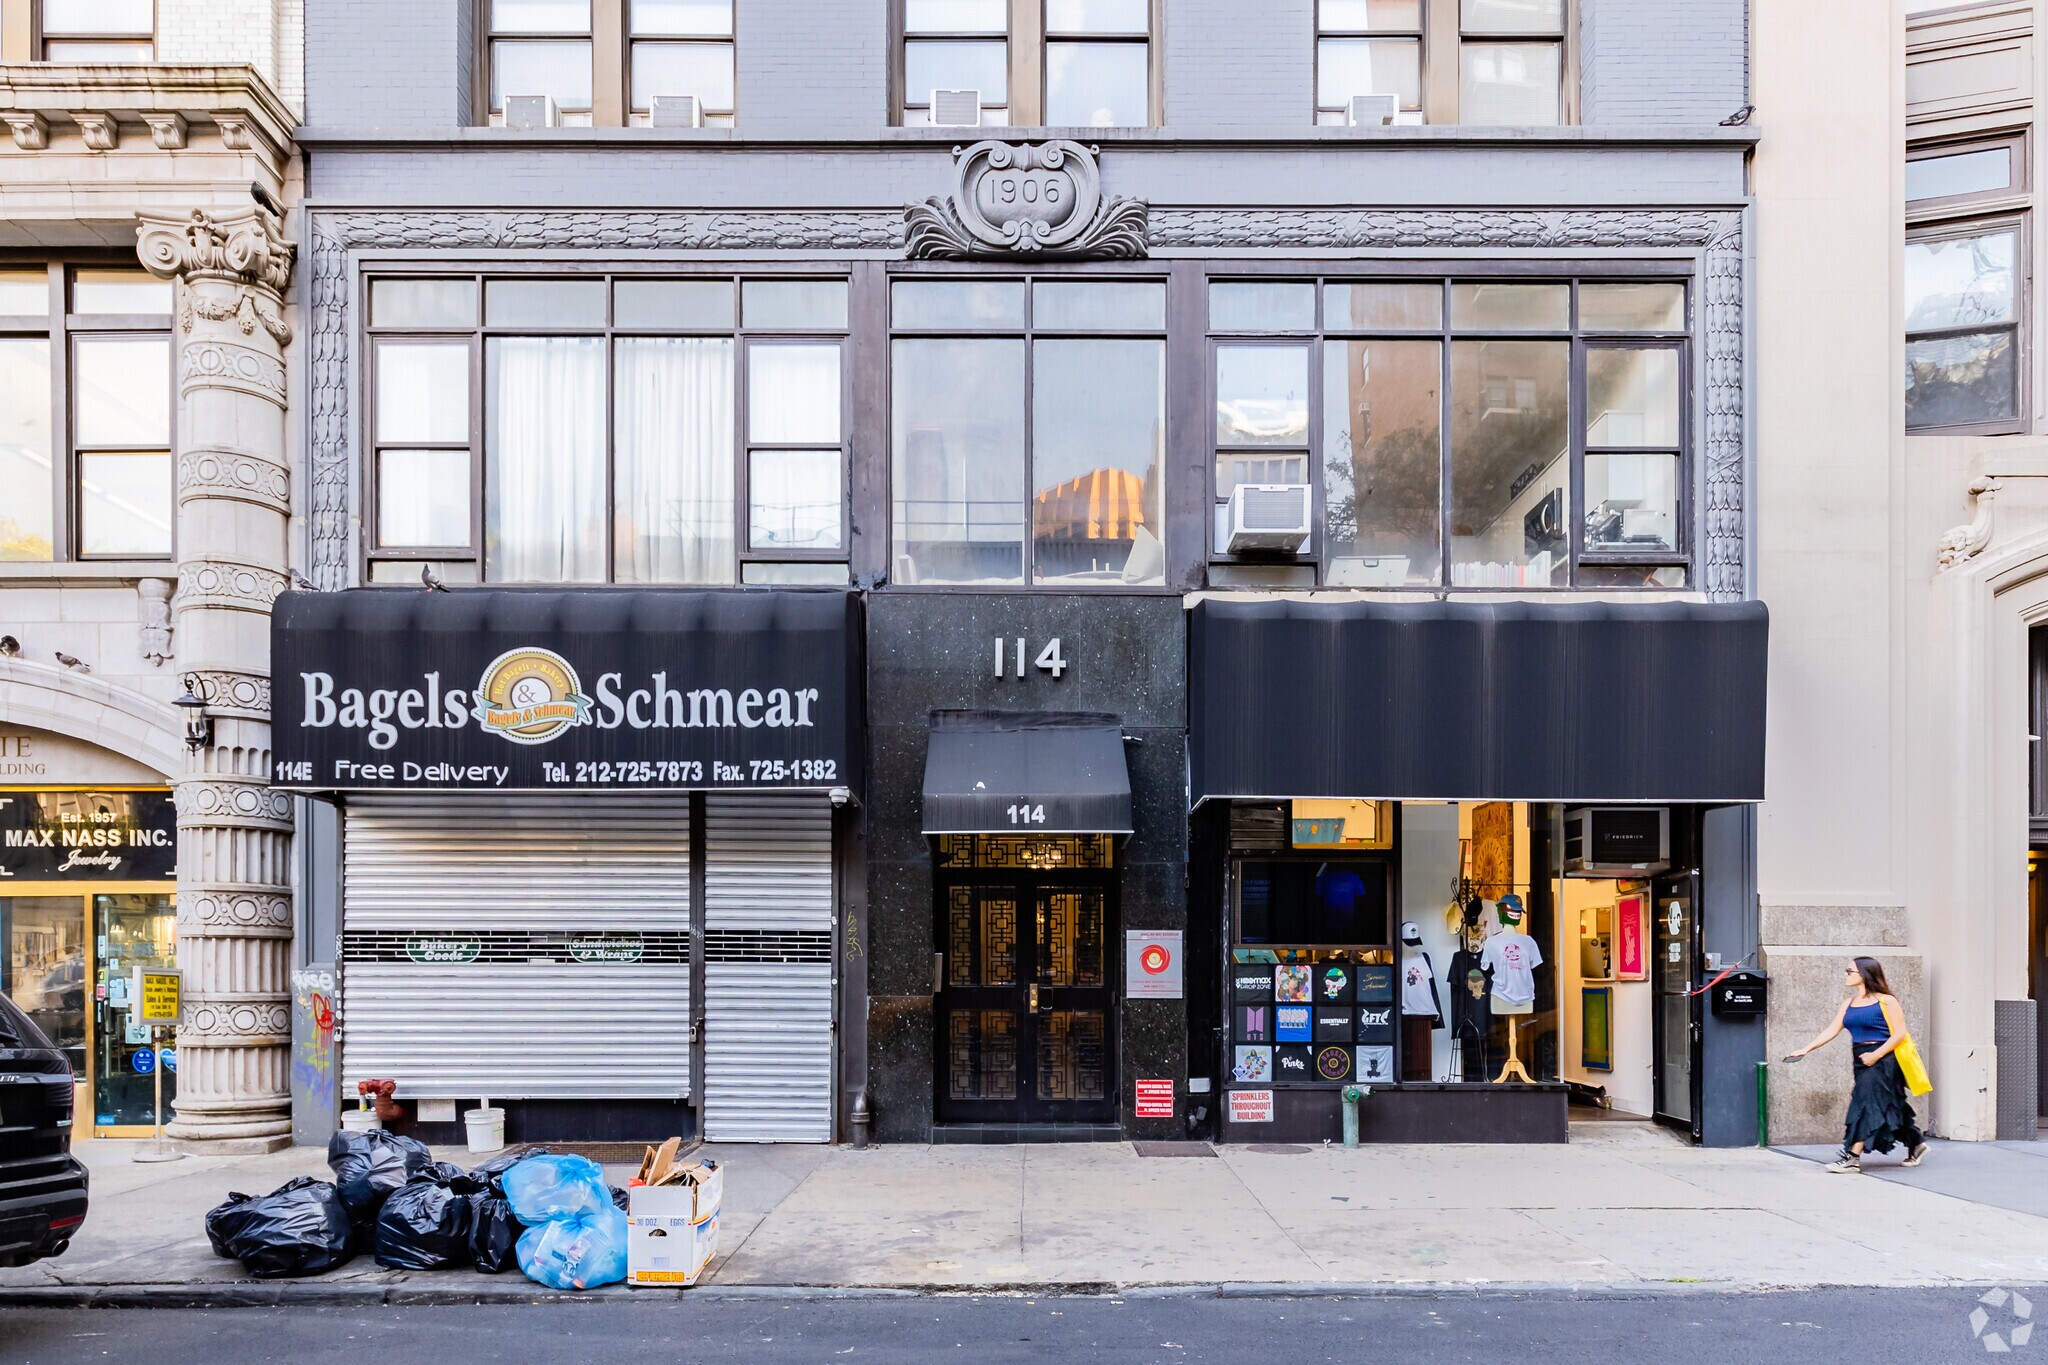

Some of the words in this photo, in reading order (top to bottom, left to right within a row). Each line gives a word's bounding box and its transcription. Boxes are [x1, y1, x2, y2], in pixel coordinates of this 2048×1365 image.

[990, 178, 1061, 204] 1906
[994, 637, 1067, 678] 114
[494, 680, 506, 695] Hot
[503, 663, 530, 680] Bagels
[540, 663, 566, 688] Bakery
[300, 671, 469, 750] Bagels
[518, 684, 537, 703] &
[595, 670, 819, 730] Schmear
[487, 710, 521, 728] Bagels
[276, 761, 312, 781] 114E
[335, 760, 395, 780] Free
[402, 762, 509, 786] Delivery
[542, 762, 571, 782] Tel.
[575, 761, 703, 782] 212-725-7873
[713, 761, 745, 781] Fax.
[749, 759, 837, 781] 725-1382
[61, 812, 85, 823] Est.
[88, 812, 118, 823] 1957
[1006, 804, 1046, 824] 114
[5, 829, 55, 848] MAX
[62, 828, 121, 847] NASS
[129, 829, 173, 846] INC.
[57, 849, 122, 872] Jewelry
[419, 939, 469, 950] Bakery
[424, 950, 464, 961] Goods
[1232, 1092, 1270, 1101] SPRINKLERS
[1231, 1102, 1272, 1111] THROUGHOUT
[1237, 1112, 1266, 1120] BUILDING
[670, 1218, 685, 1227] EGGS
